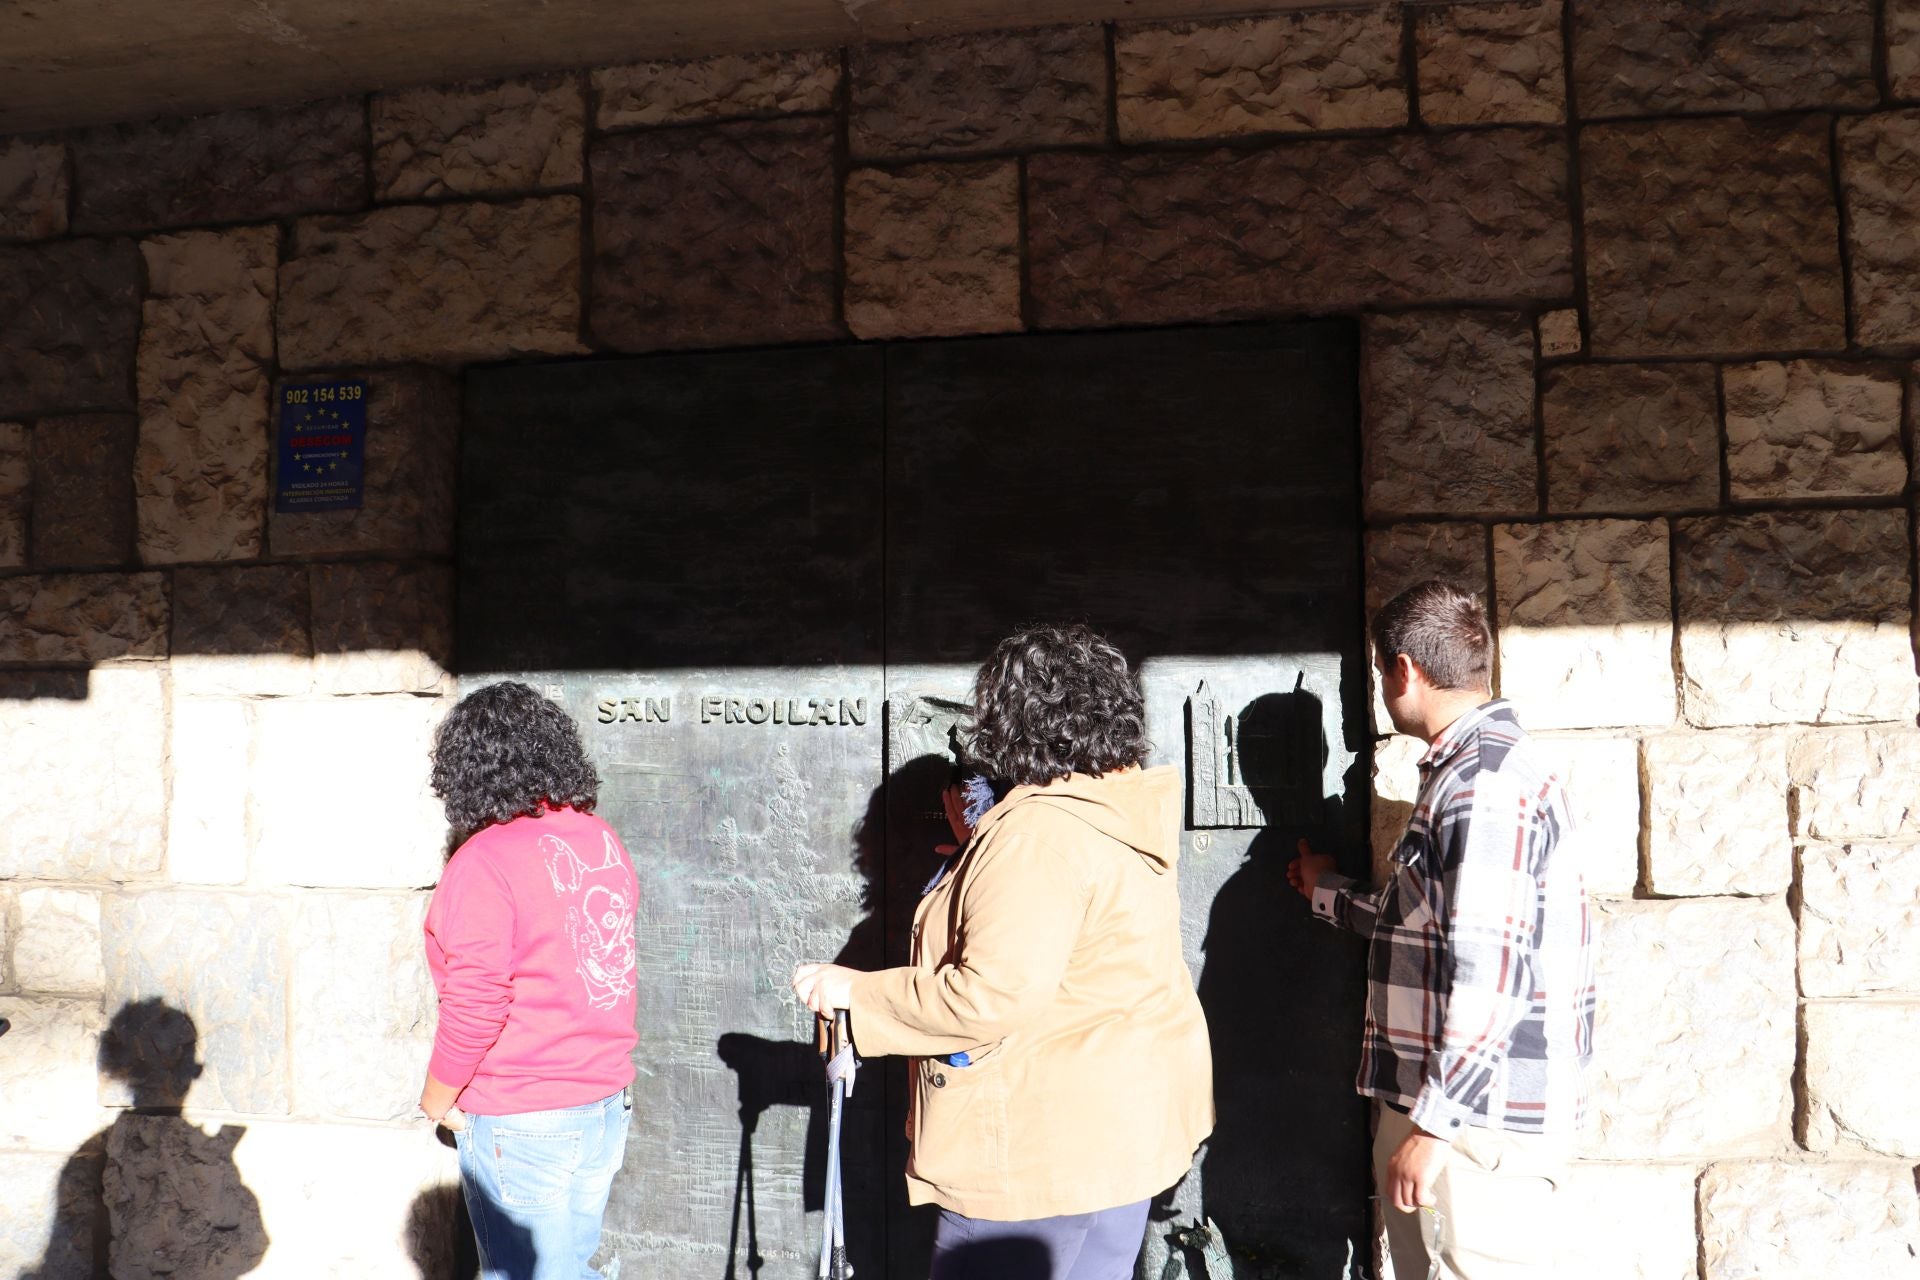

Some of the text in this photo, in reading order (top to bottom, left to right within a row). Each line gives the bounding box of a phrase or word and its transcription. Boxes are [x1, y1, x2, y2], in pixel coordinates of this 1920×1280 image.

[286, 385, 362, 405] 902 154 539
[597, 695, 868, 727] SAN FROILAN
